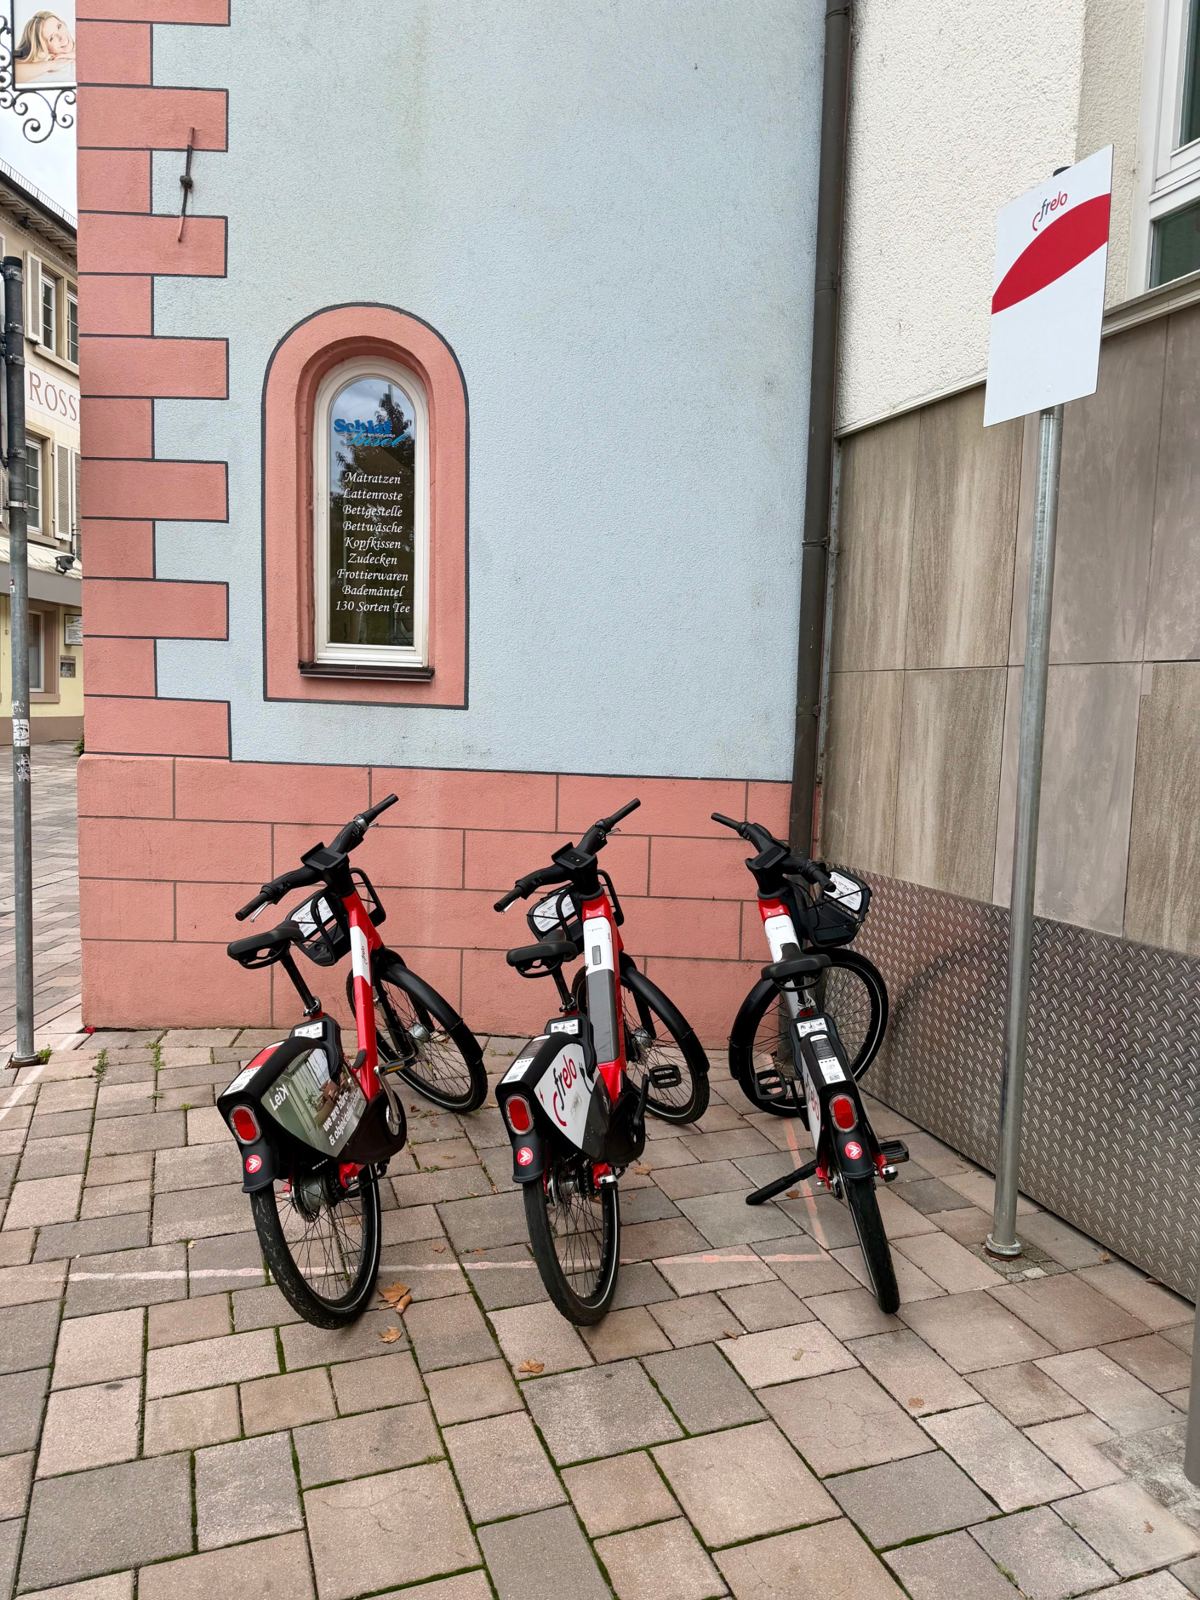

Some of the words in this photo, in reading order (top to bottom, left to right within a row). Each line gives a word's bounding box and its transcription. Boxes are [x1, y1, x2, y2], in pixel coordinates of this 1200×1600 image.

[1036, 191, 1068, 225] frelo
[29, 371, 80, 424] RÖSS
[344, 472, 401, 484] Matratzen
[343, 488, 403, 501] Lattenroste
[342, 505, 403, 519] Bettgestelle
[342, 521, 403, 533] Bettwäsche
[344, 537, 401, 551] Kopfkissen
[348, 553, 398, 567] Zudecken
[337, 569, 409, 582] Frottierwaren
[342, 584, 406, 597] Bademäntel
[336, 601, 355, 611] 130
[356, 602, 390, 613] Sorten
[393, 602, 411, 613] Tee
[553, 1054, 578, 1111] frelo
